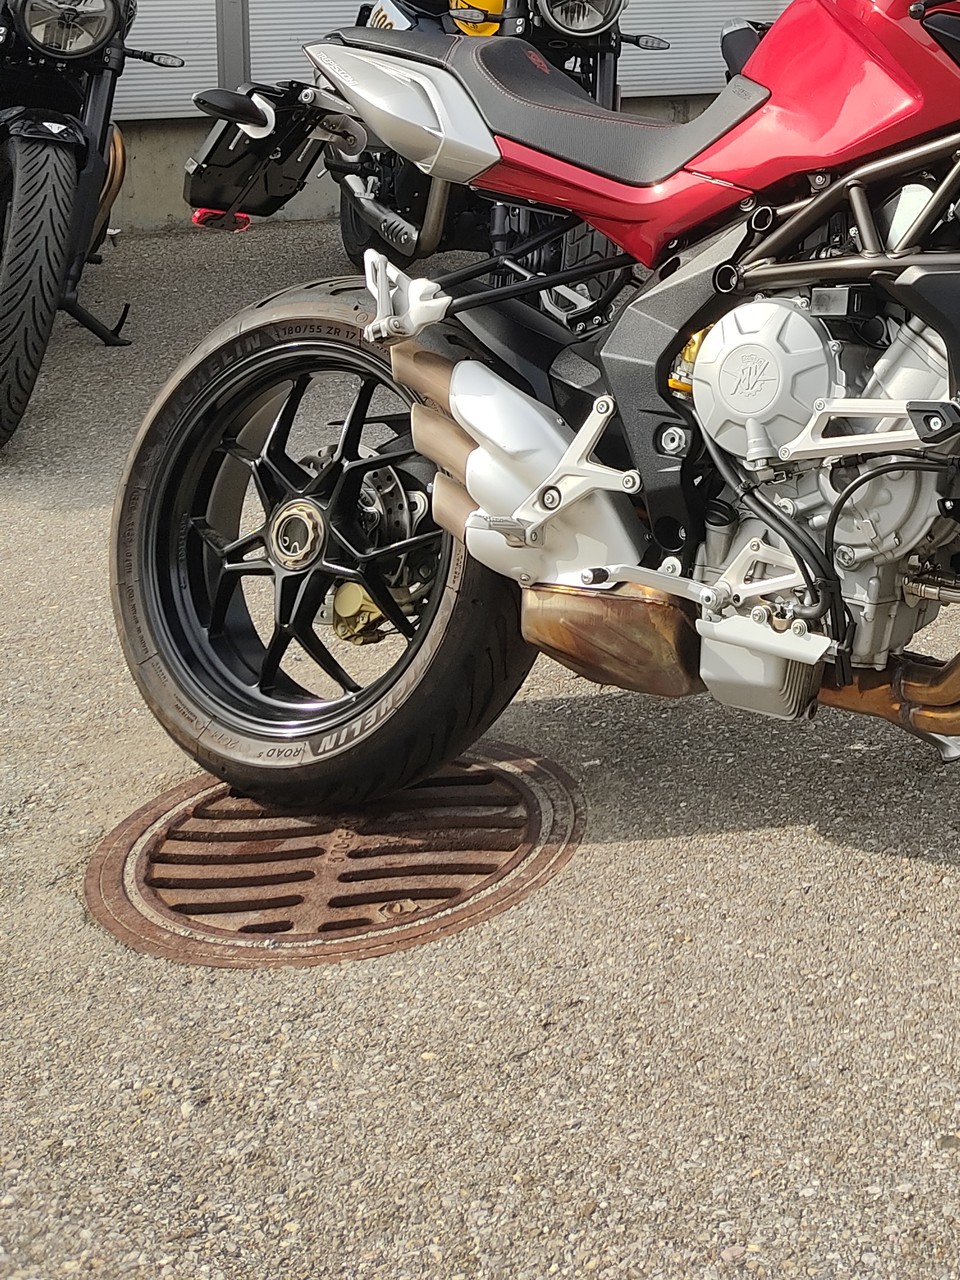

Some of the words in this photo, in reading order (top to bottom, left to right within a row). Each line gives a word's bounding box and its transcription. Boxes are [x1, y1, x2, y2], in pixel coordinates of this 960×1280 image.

[282, 324, 322, 336] 180/55
[325, 325, 342, 337] ZR
[344, 330, 358, 340] 17
[156, 332, 261, 438] MICHELIN
[266, 746, 303, 758] ROAD
